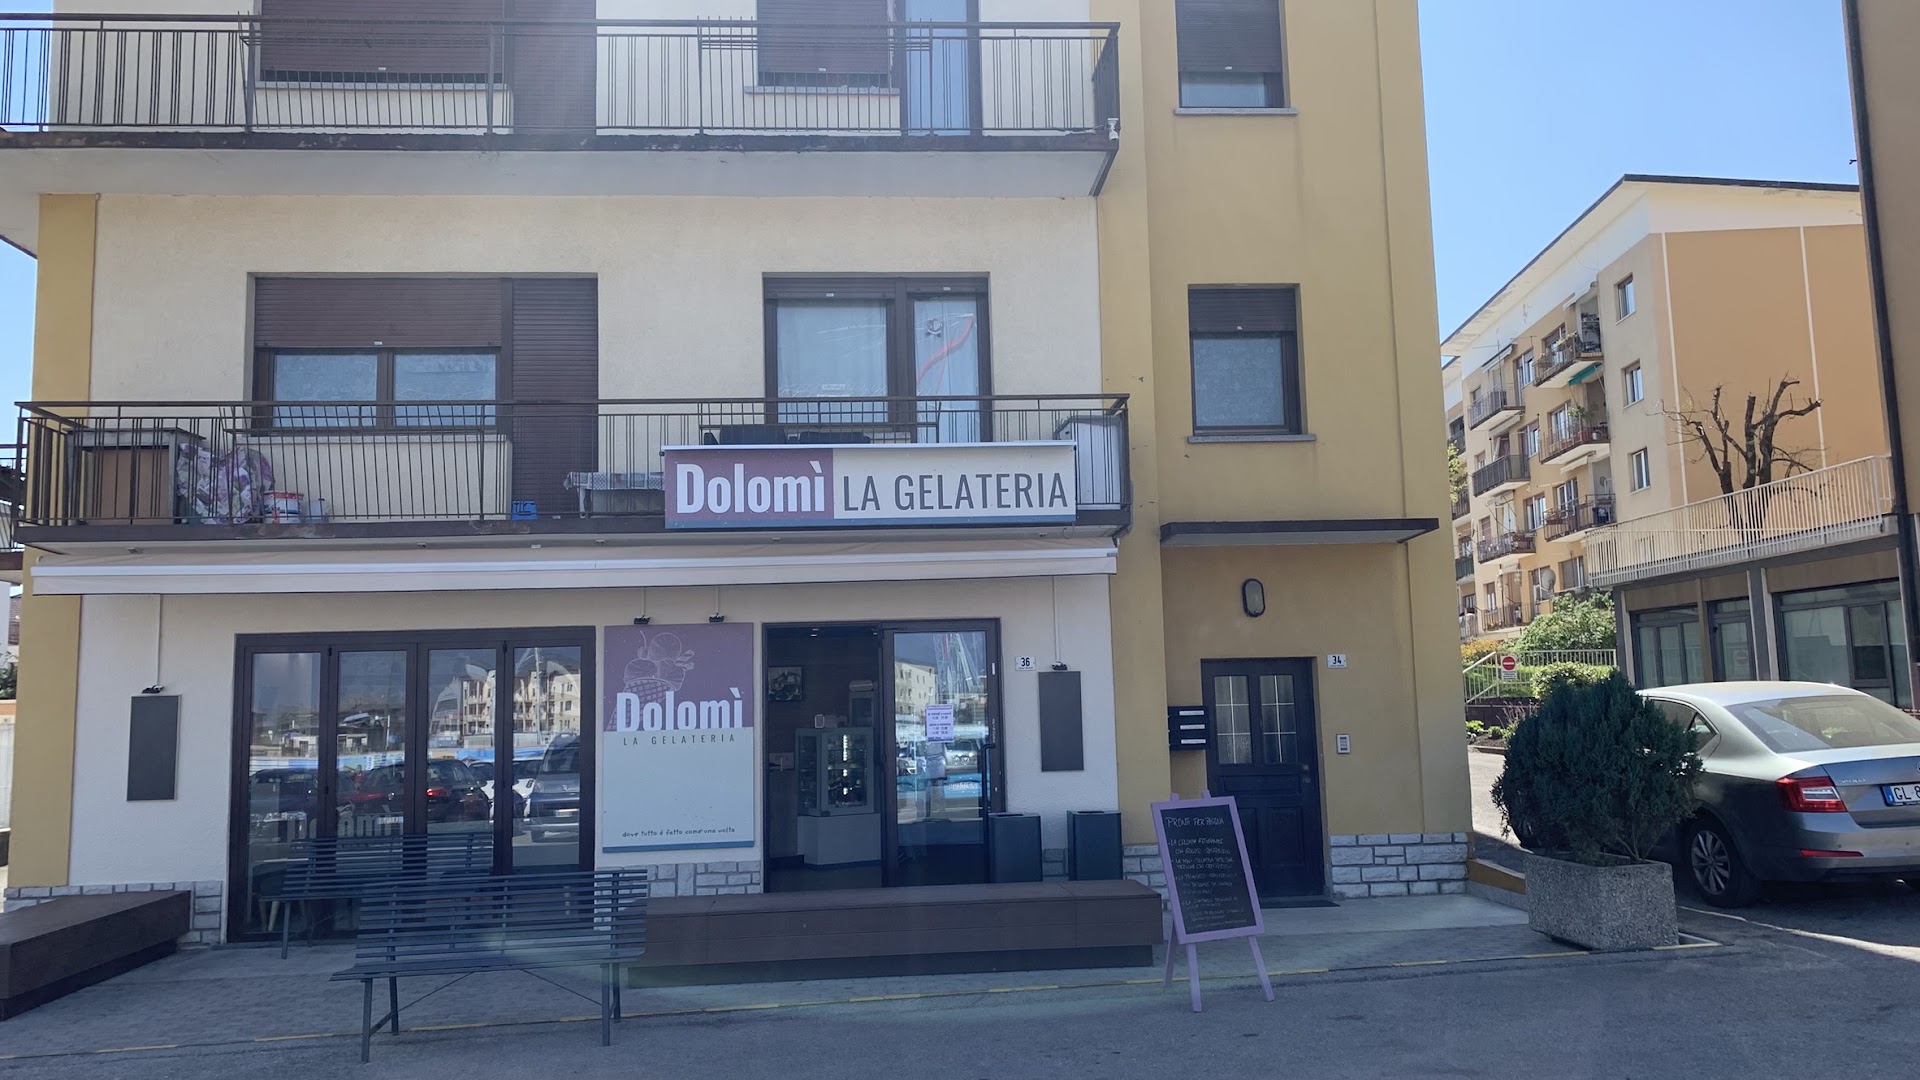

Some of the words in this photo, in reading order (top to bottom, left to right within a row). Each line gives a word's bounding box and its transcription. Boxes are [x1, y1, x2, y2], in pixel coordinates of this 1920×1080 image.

[676, 460, 825, 514] Dolomì
[843, 475, 880, 511] LA
[894, 472, 1068, 510] GELATERIA
[1020, 657, 1031, 667] 36
[1332, 656, 1342, 664] 34
[616, 687, 743, 732] Dolomì
[623, 737, 638, 746] LA
[652, 734, 735, 745] GELATERIA
[1894, 787, 1912, 800] GL
[641, 829, 658, 837] tutto
[665, 828, 683, 836] fatto
[717, 826, 735, 834] volta
